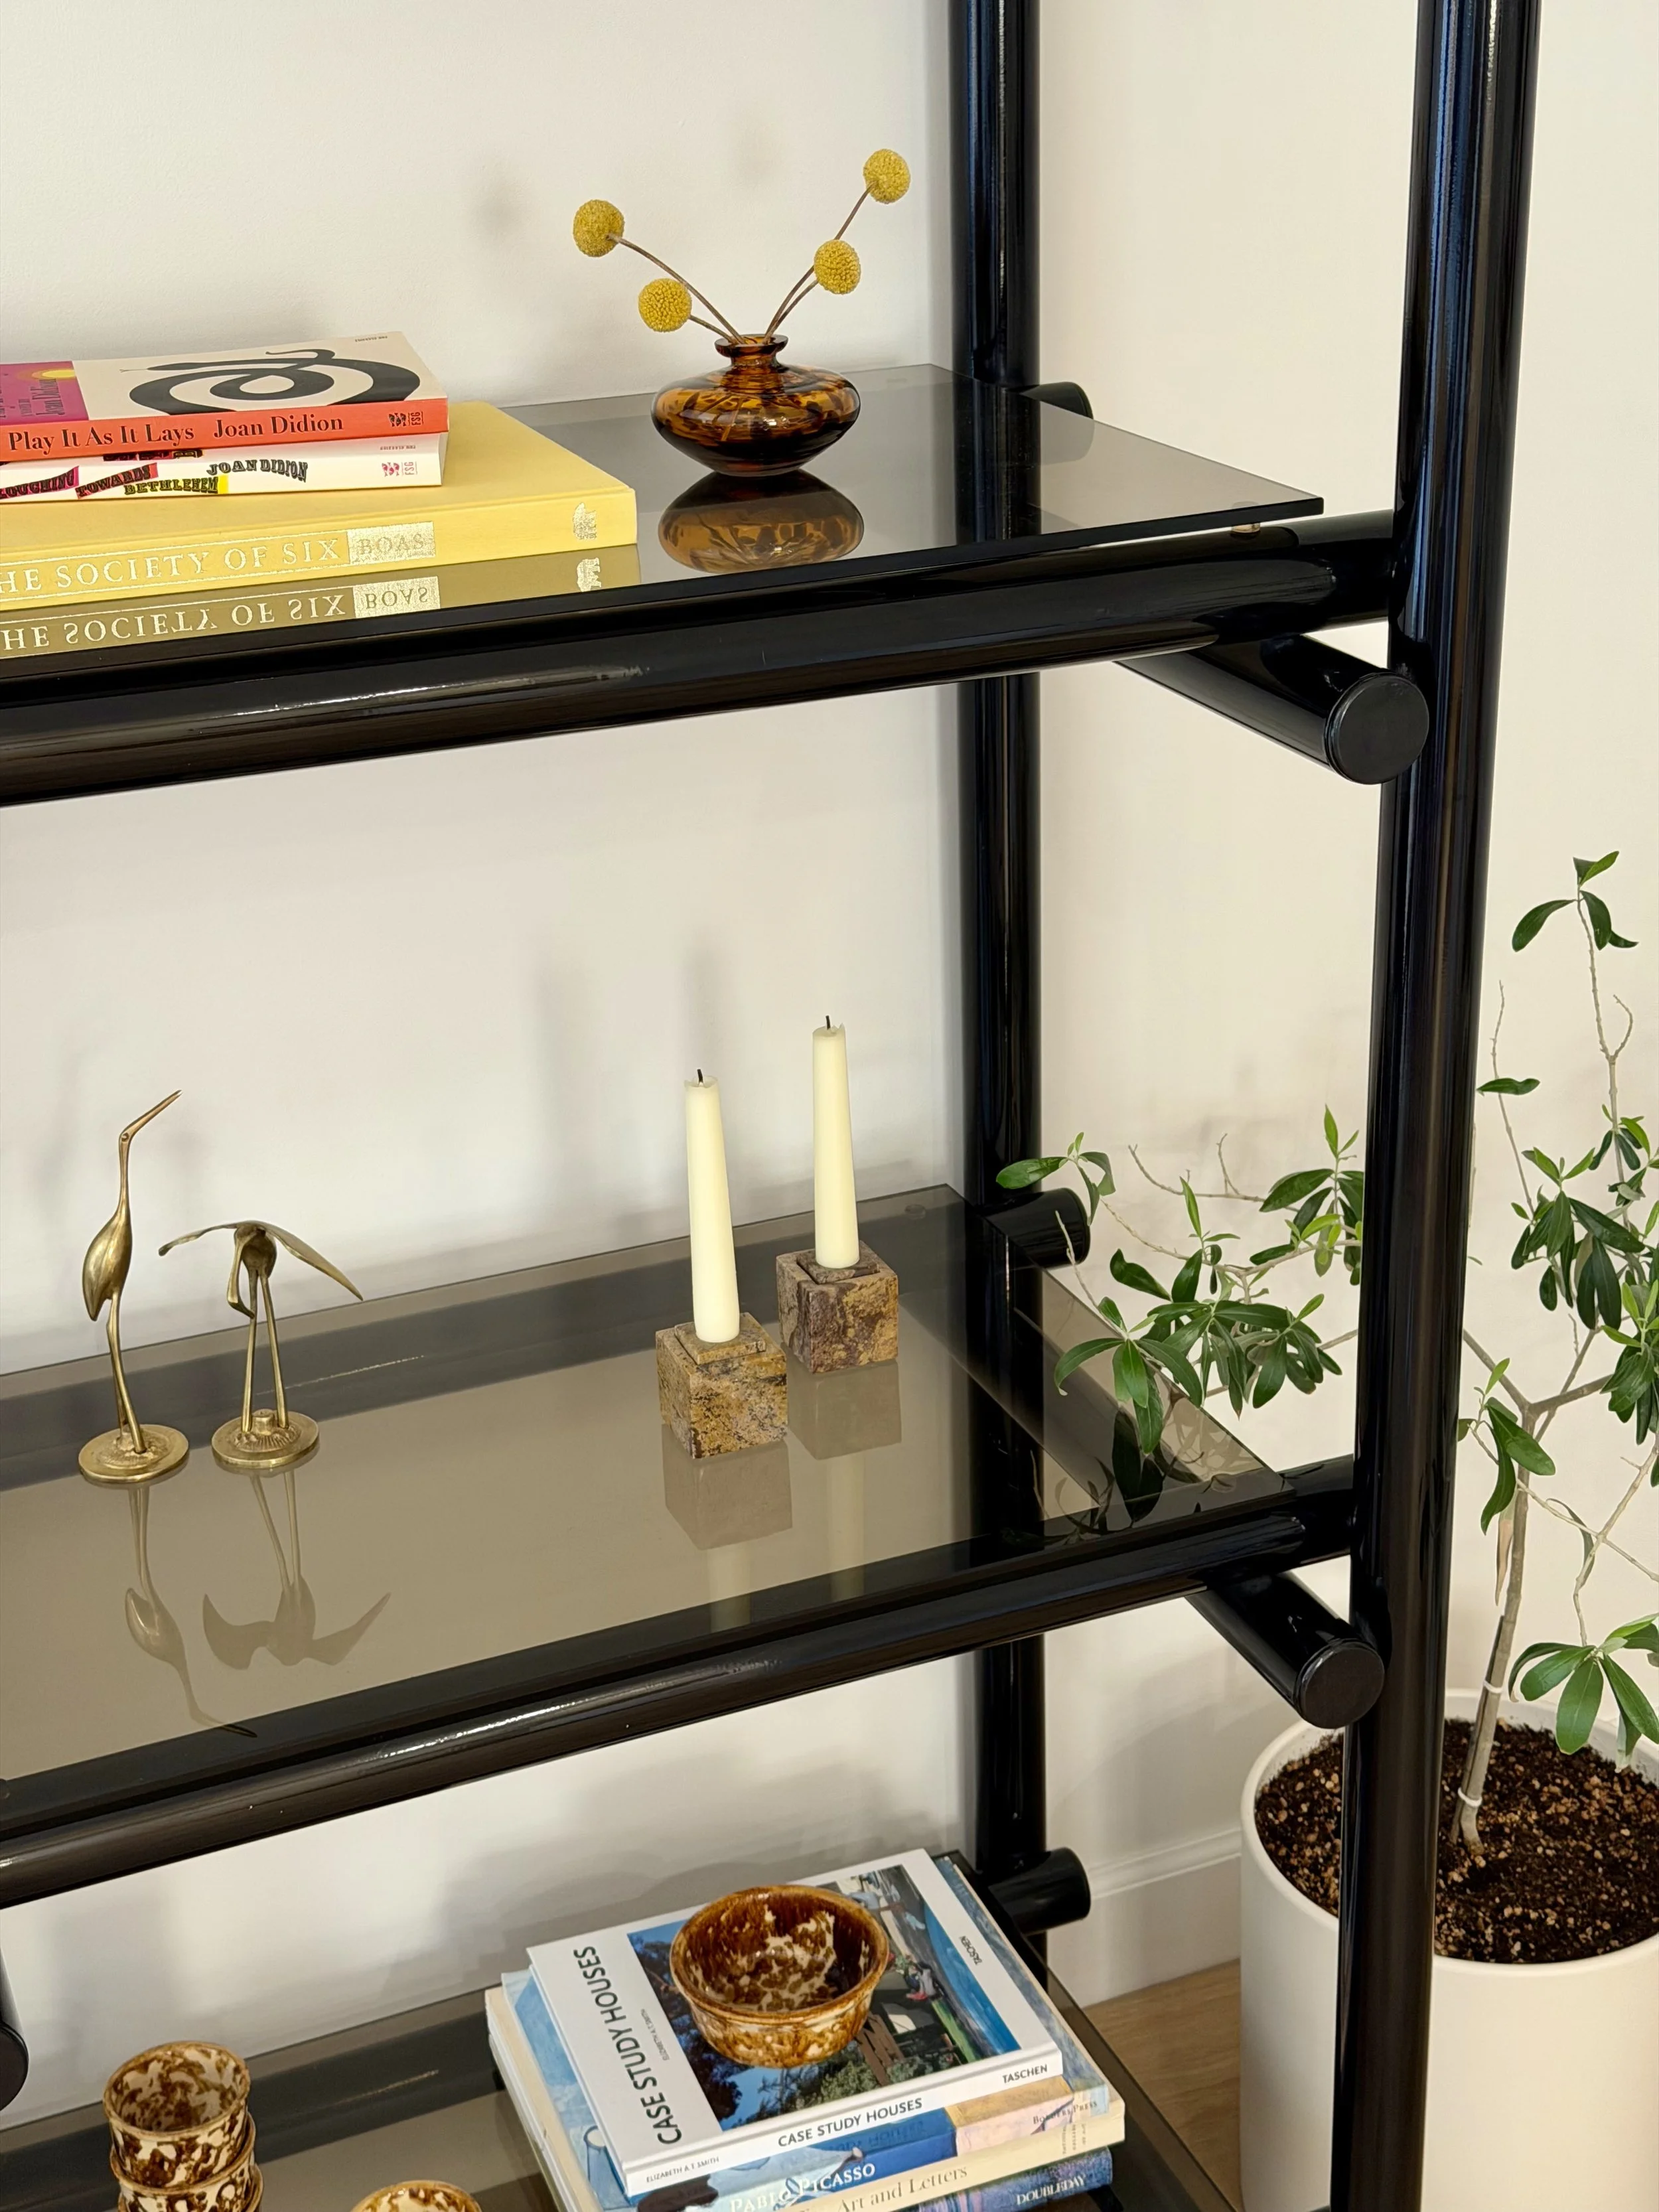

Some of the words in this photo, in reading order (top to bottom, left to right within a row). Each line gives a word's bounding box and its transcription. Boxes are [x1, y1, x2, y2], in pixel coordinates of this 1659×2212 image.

[9, 431, 54, 455] Play
[61, 429, 81, 447] It
[85, 427, 113, 446] As
[120, 425, 139, 443] It
[145, 423, 194, 447] Lays
[214, 419, 263, 438] Joan
[271, 413, 343, 435] Didion
[411, 411, 421, 425] FSG
[124, 477, 219, 494] BETHLEHEM
[206, 459, 257, 475] JOAN
[259, 459, 309, 482] DIDION
[404, 461, 415, 475] FSG
[57, 552, 209, 589] SOCIETY
[224, 546, 268, 570] OF
[283, 539, 340, 564] SIX
[359, 533, 424, 555] BOAS
[573, 1947, 626, 2024] HOUSES
[609, 2028, 657, 2090] STUDY
[640, 2092, 682, 2144] CASE
[646, 2166, 682, 2183] ELIZABETH
[697, 2156, 720, 2169] SMITH
[778, 2128, 813, 2147] CASE
[818, 2114, 861, 2136] STUDY
[867, 2097, 922, 2123] HOUSES
[1003, 2064, 1048, 2083] TASCHEN
[731, 2190, 792, 2212] PABLO
[799, 2163, 875, 2195] PICASSO
[837, 2195, 864, 2212] Art
[871, 2182, 902, 2205] and
[910, 2166, 968, 2193] Letters
[1017, 2174, 1086, 2205] DOUBLEDAY
